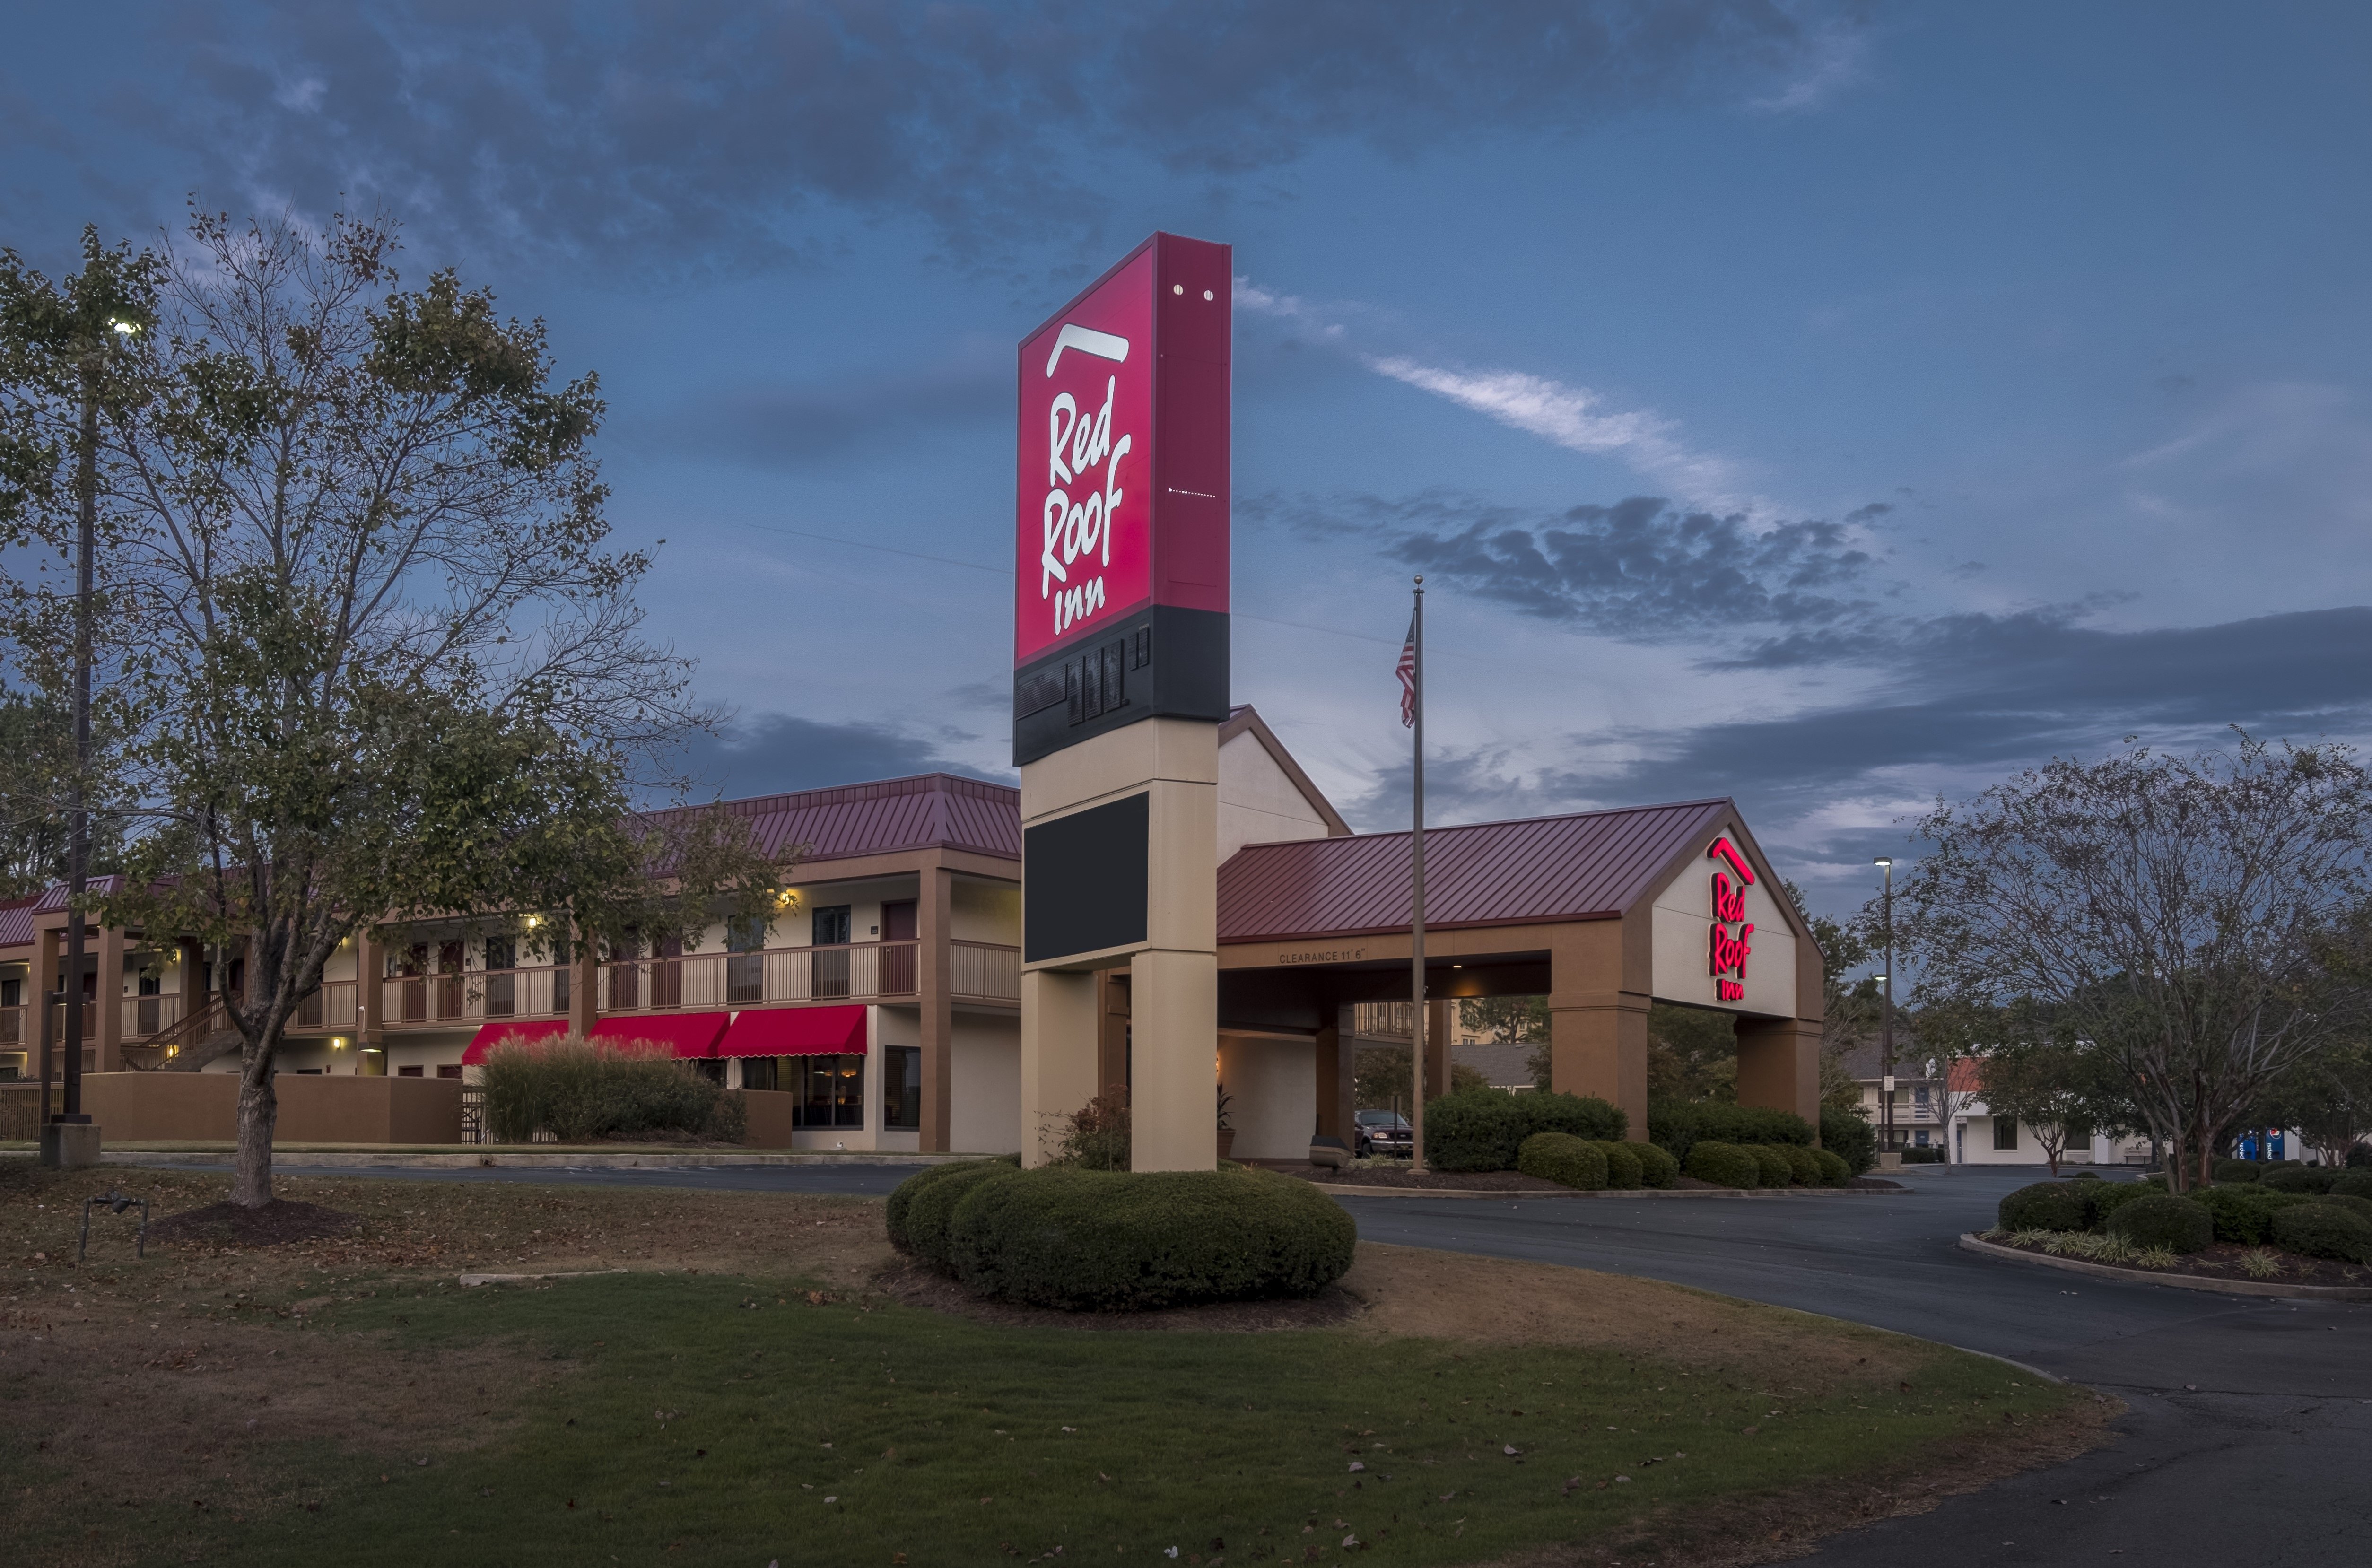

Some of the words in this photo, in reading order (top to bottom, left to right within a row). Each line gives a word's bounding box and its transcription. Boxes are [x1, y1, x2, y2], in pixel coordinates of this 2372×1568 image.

[1050, 375, 1116, 487] Red
[1041, 434, 1131, 600] Roof
[1717, 872, 1745, 923] Red
[1279, 951, 1338, 964] CLEARANCE
[1715, 923, 1754, 979] Roof
[1721, 978, 1744, 1001] Inn
